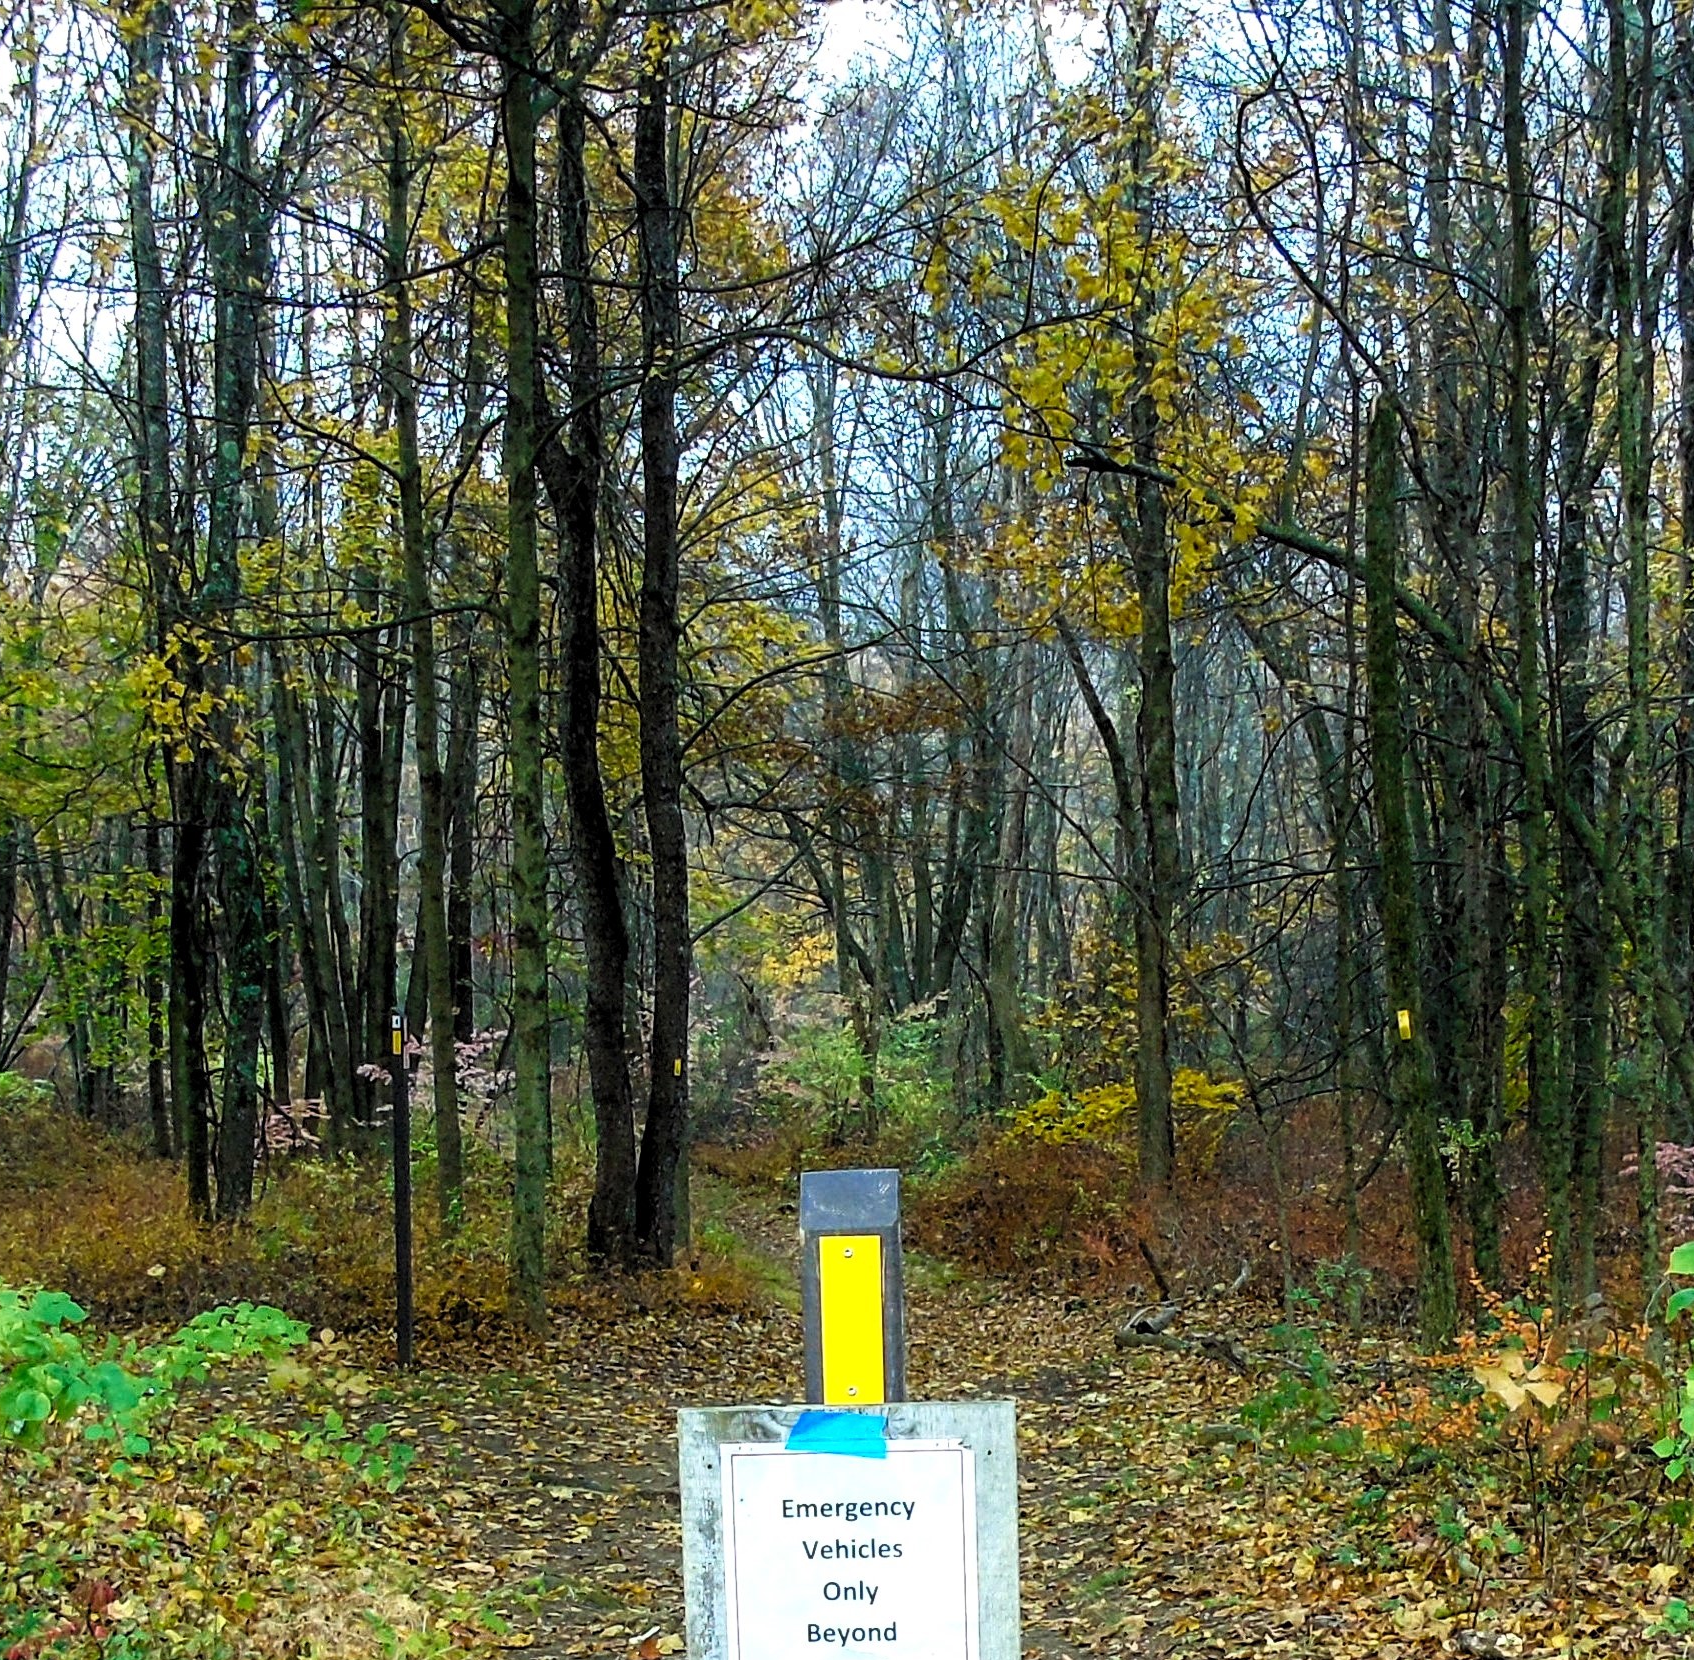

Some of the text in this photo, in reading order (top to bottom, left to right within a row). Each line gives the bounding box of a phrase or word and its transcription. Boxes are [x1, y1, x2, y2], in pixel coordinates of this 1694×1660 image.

[782, 1499, 915, 1521] Emergency
[802, 1538, 903, 1559] Vehicles
[823, 1580, 878, 1604] Only
[807, 1621, 897, 1647] Beyond
